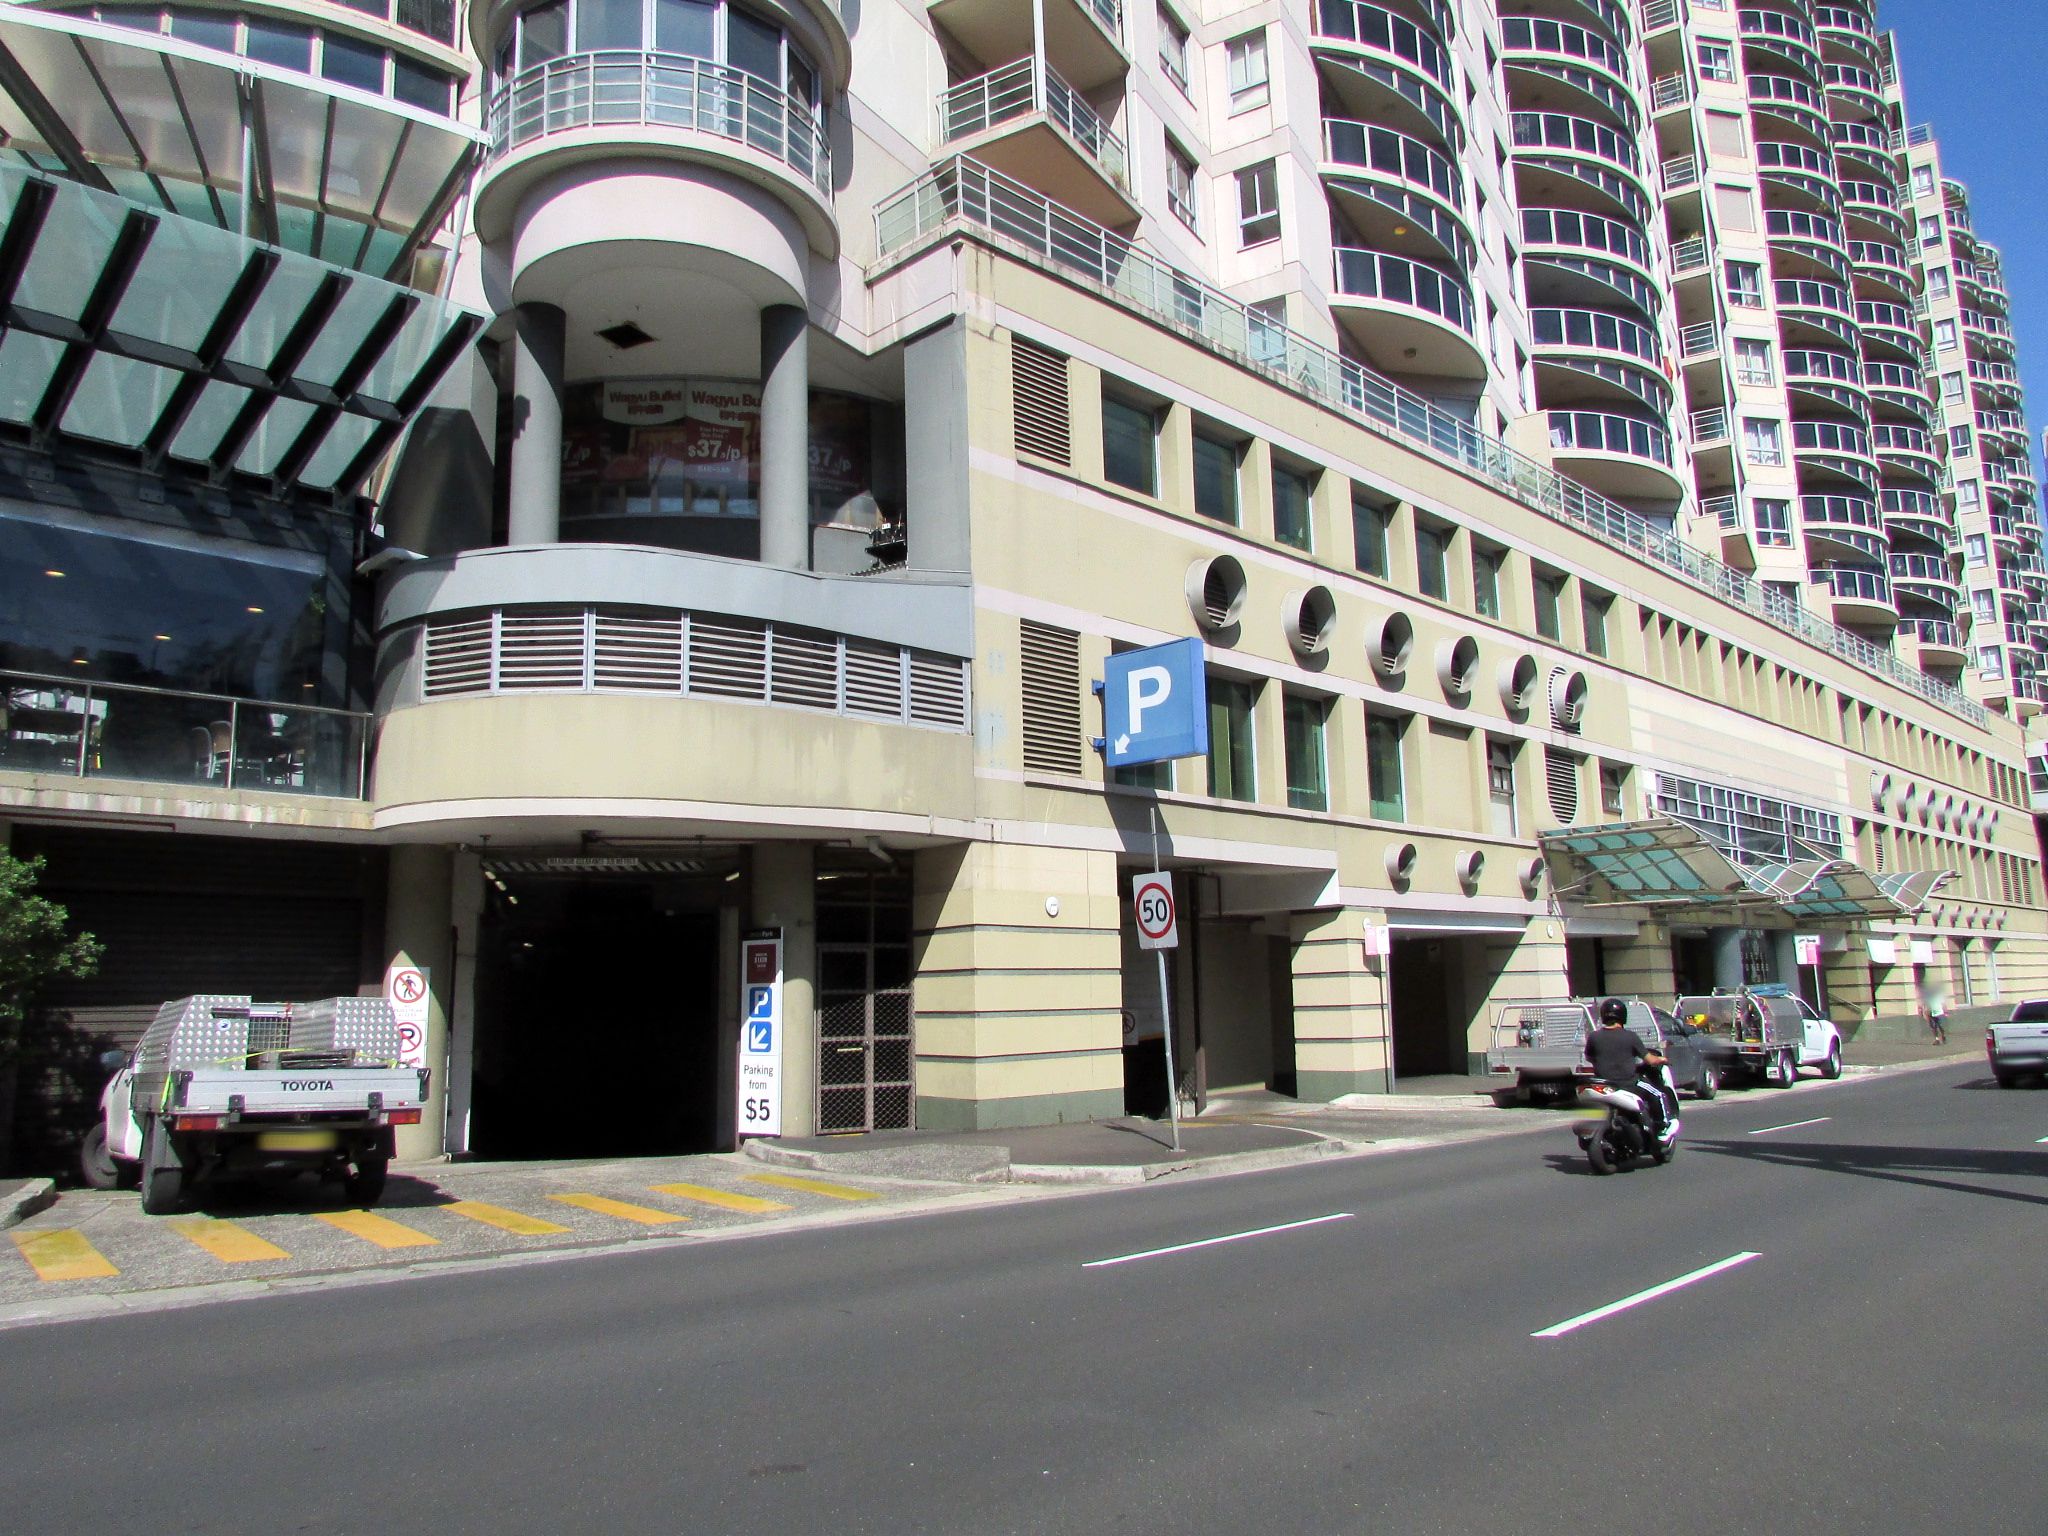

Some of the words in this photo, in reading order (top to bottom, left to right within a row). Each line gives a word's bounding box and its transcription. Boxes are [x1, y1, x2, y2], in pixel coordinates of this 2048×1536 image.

[692, 390, 740, 408] Wagyu
[1128, 665, 1172, 734] P
[1142, 898, 1168, 924] 50
[753, 990, 769, 1015] P
[743, 1064, 774, 1078] Parking
[281, 1080, 334, 1092] TOYOTA
[748, 1079, 767, 1090] from
[745, 1098, 771, 1123] $5
